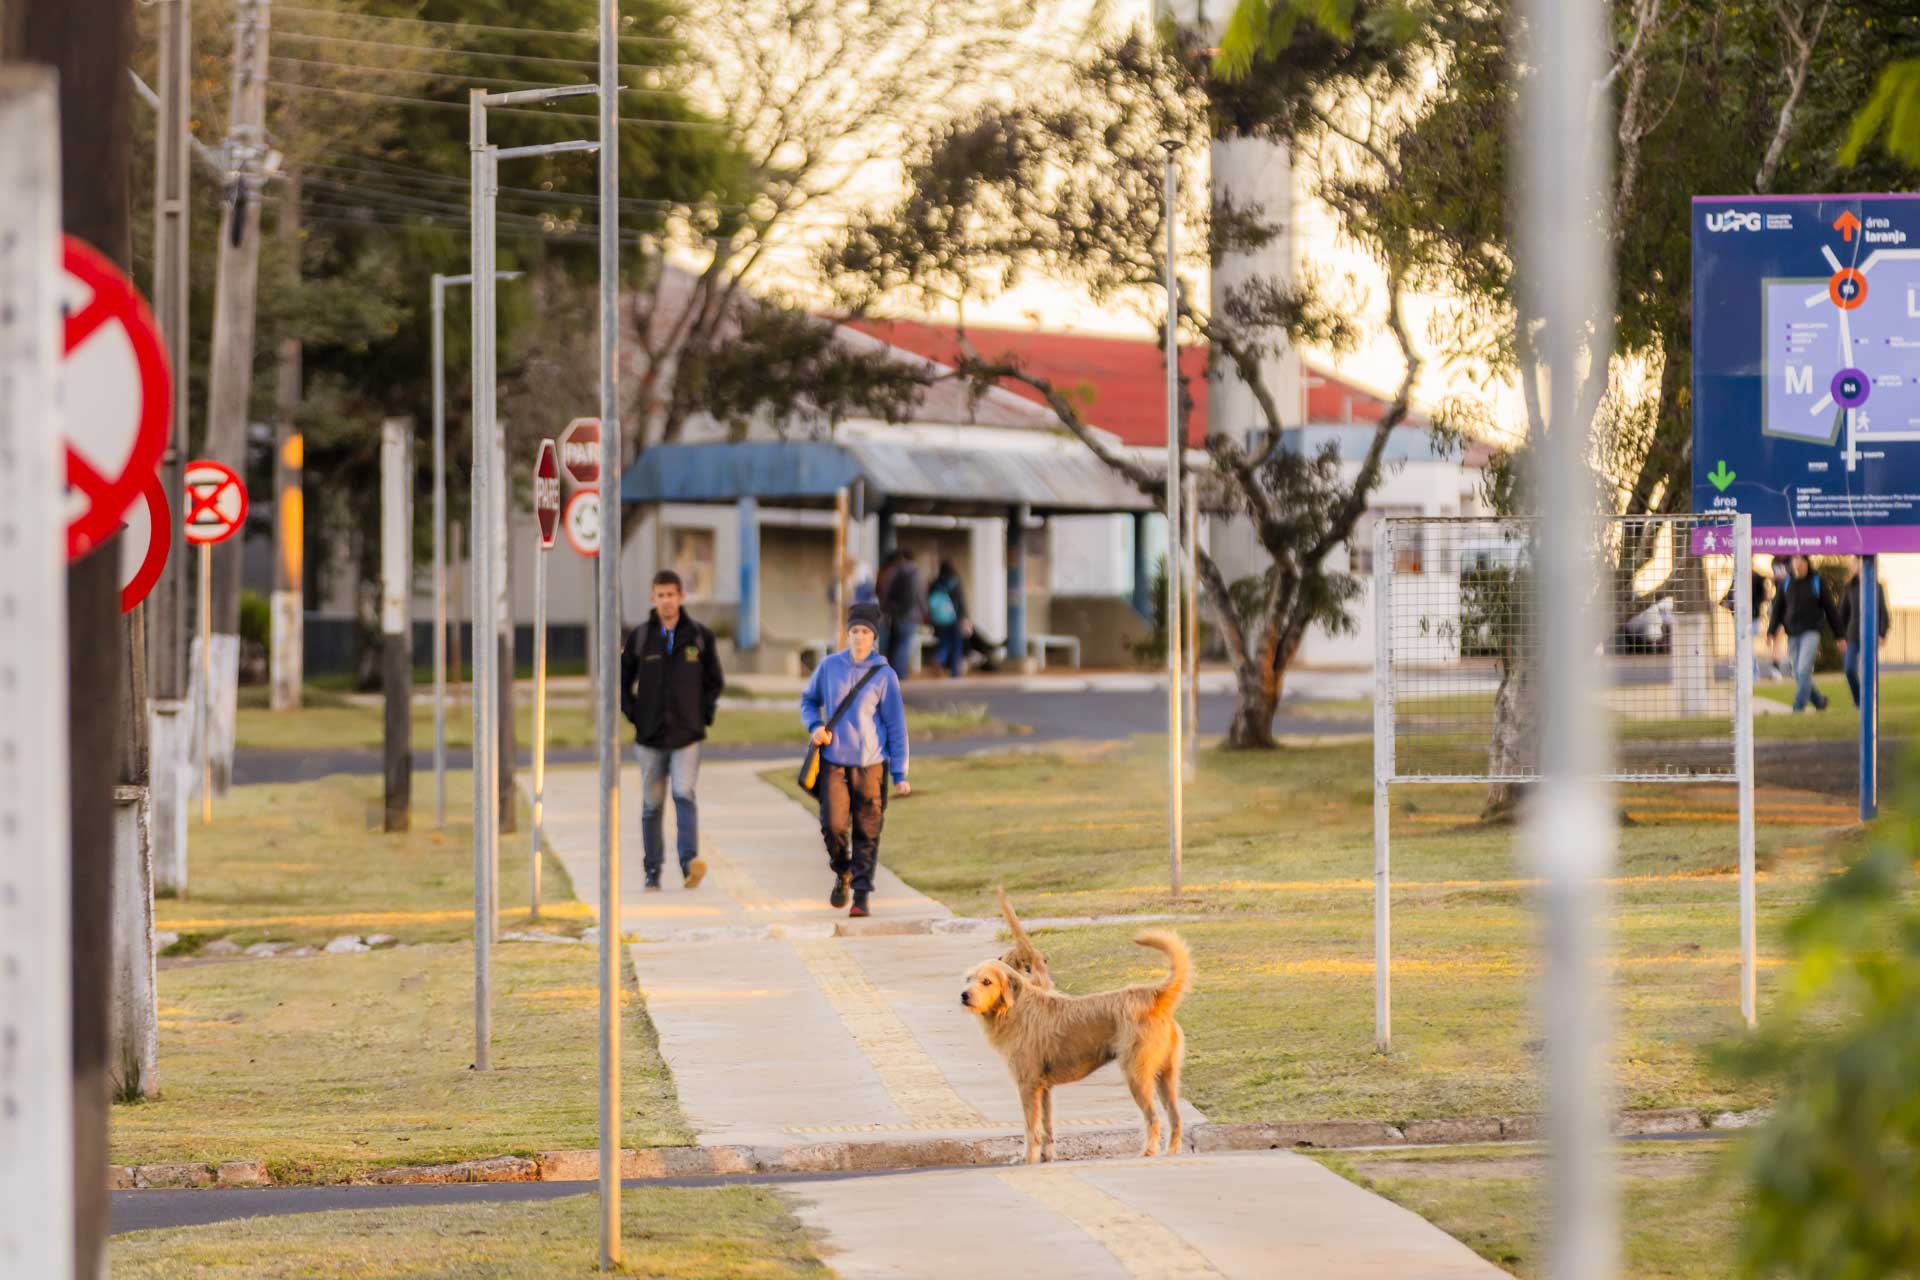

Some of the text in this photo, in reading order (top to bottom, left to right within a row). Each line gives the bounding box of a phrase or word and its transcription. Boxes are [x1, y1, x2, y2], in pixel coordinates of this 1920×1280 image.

[1866, 217, 1889, 229] área
[1865, 230, 1906, 244] laranja
[1785, 366, 1813, 394] M
[1844, 383, 1856, 393] R4
[566, 441, 600, 465] PAR
[1713, 496, 1737, 507] área
[1765, 538, 1776, 546] na
[1778, 536, 1798, 546] área
[1801, 537, 1821, 546] rosa
[1825, 536, 1837, 545] R4
